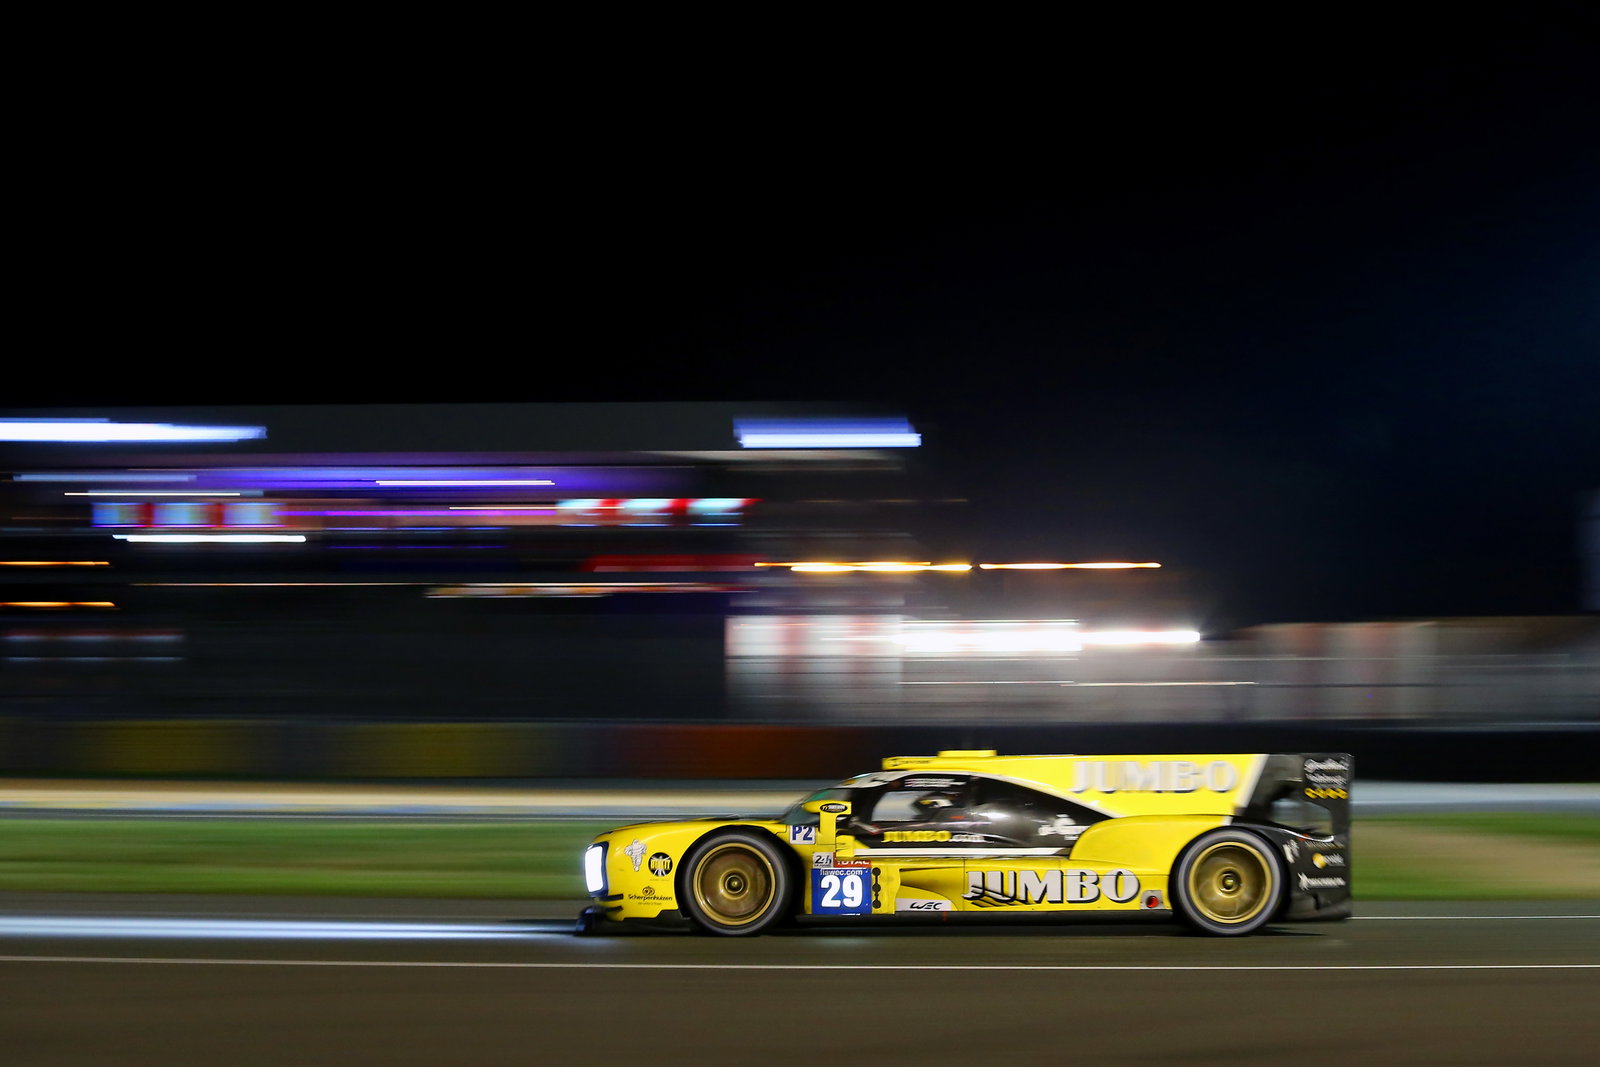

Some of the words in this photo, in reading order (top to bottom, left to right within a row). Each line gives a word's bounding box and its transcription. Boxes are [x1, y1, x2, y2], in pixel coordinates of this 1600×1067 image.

[1070, 761, 1237, 793] JUMBO
[792, 824, 813, 841] P2
[821, 875, 862, 908] 29
[961, 868, 1140, 904] JUMBO
[910, 902, 943, 910] WEC
